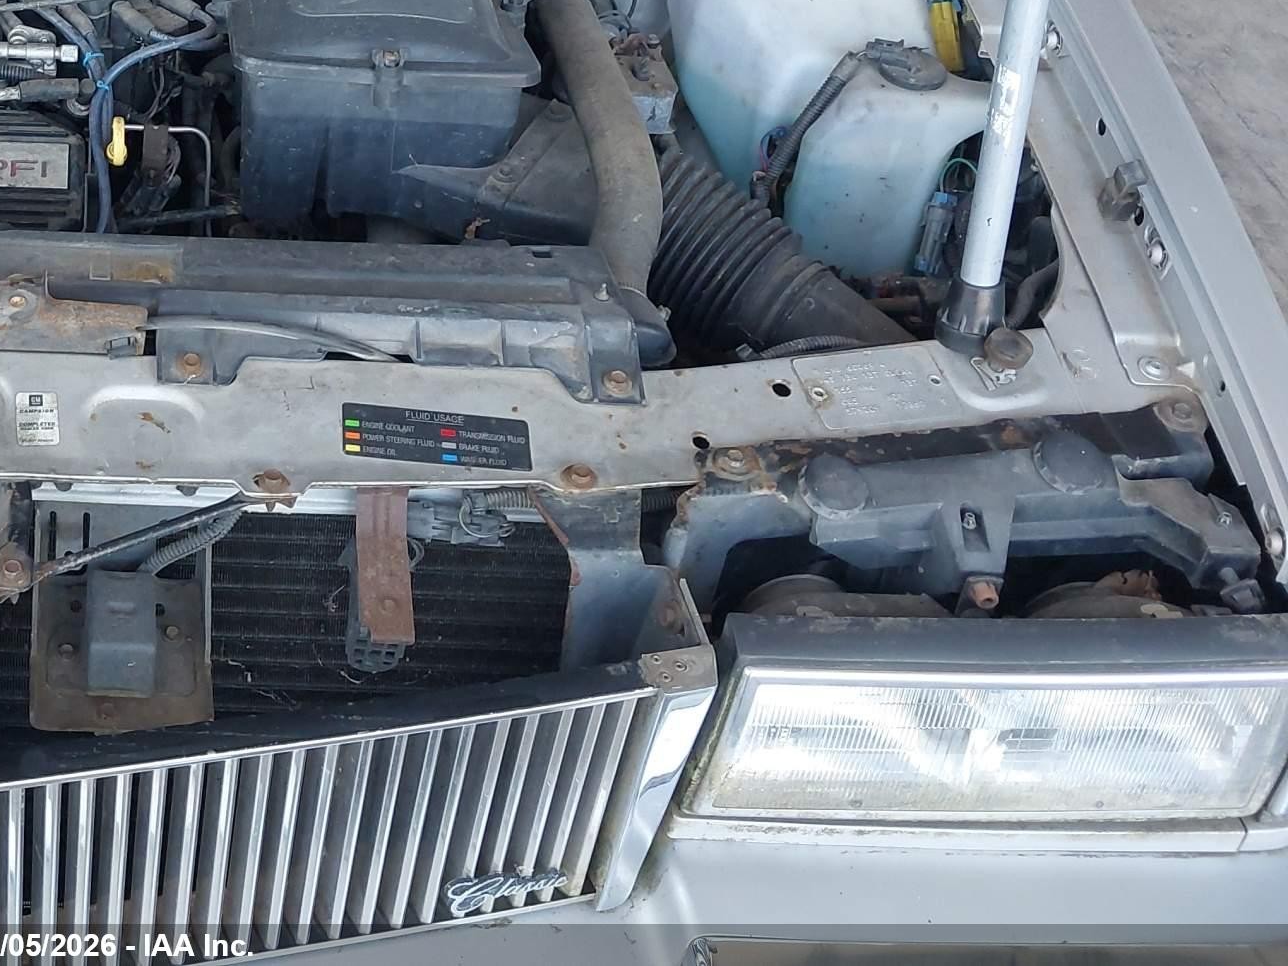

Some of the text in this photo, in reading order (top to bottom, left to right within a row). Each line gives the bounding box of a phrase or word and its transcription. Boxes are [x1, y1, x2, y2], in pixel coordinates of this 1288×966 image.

[405, 410, 464, 424] FLUID USAGE
[361, 421, 415, 433] ENGINE COOLANT
[362, 433, 435, 447] POWER STEERING FLUID
[458, 430, 526, 444] TRANSMISSION FLUID
[362, 445, 385, 455] ENGINE
[458, 443, 499, 455] BRAKE FLUID
[489, 457, 507, 466] FLUID
[447, 875, 568, 914] Classic
